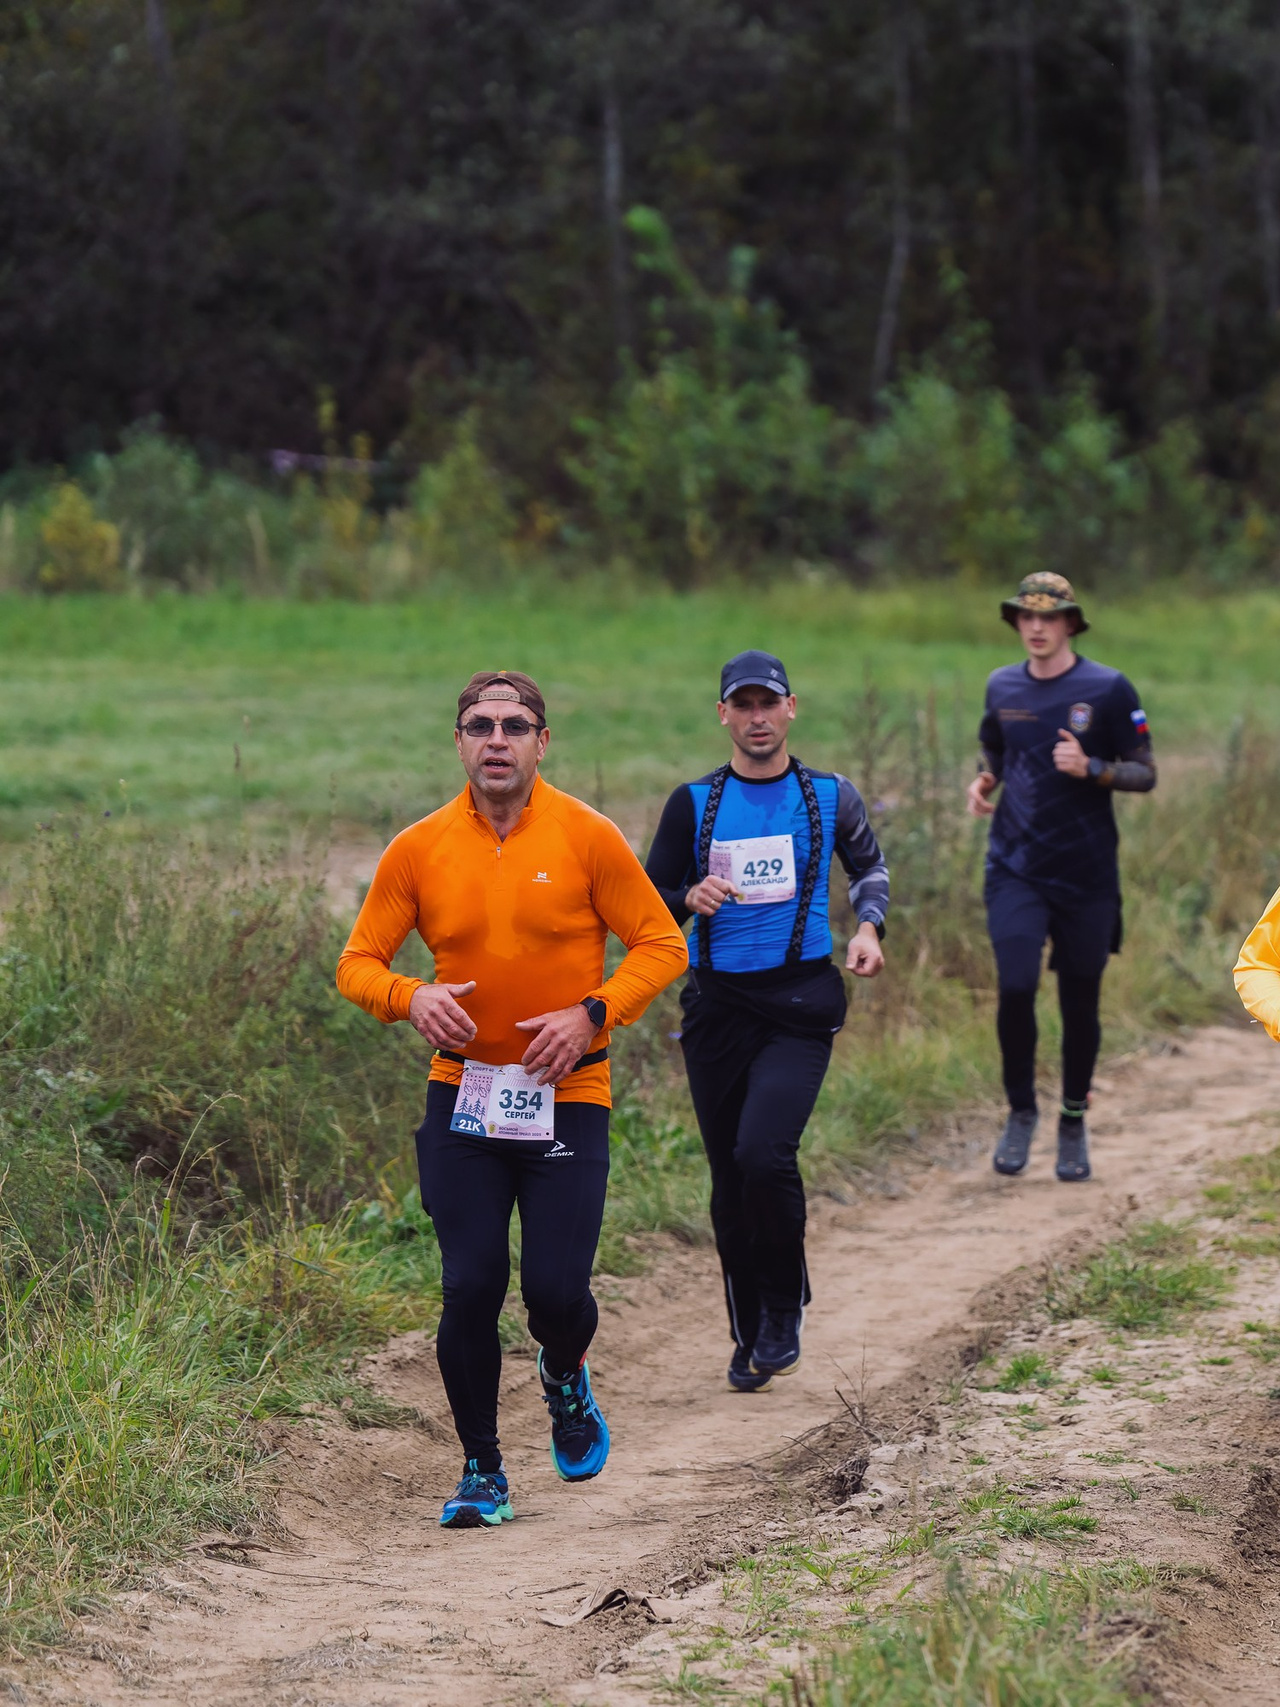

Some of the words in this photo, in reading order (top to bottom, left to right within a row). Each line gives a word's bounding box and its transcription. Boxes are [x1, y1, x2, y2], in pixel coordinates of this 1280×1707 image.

[744, 859, 782, 877] 429
[741, 877, 788, 886] АЛЕКСАНДР
[499, 1089, 542, 1111] 354
[505, 1111, 535, 1119] СЕРГЕЙ
[459, 1120, 481, 1132] 21K
